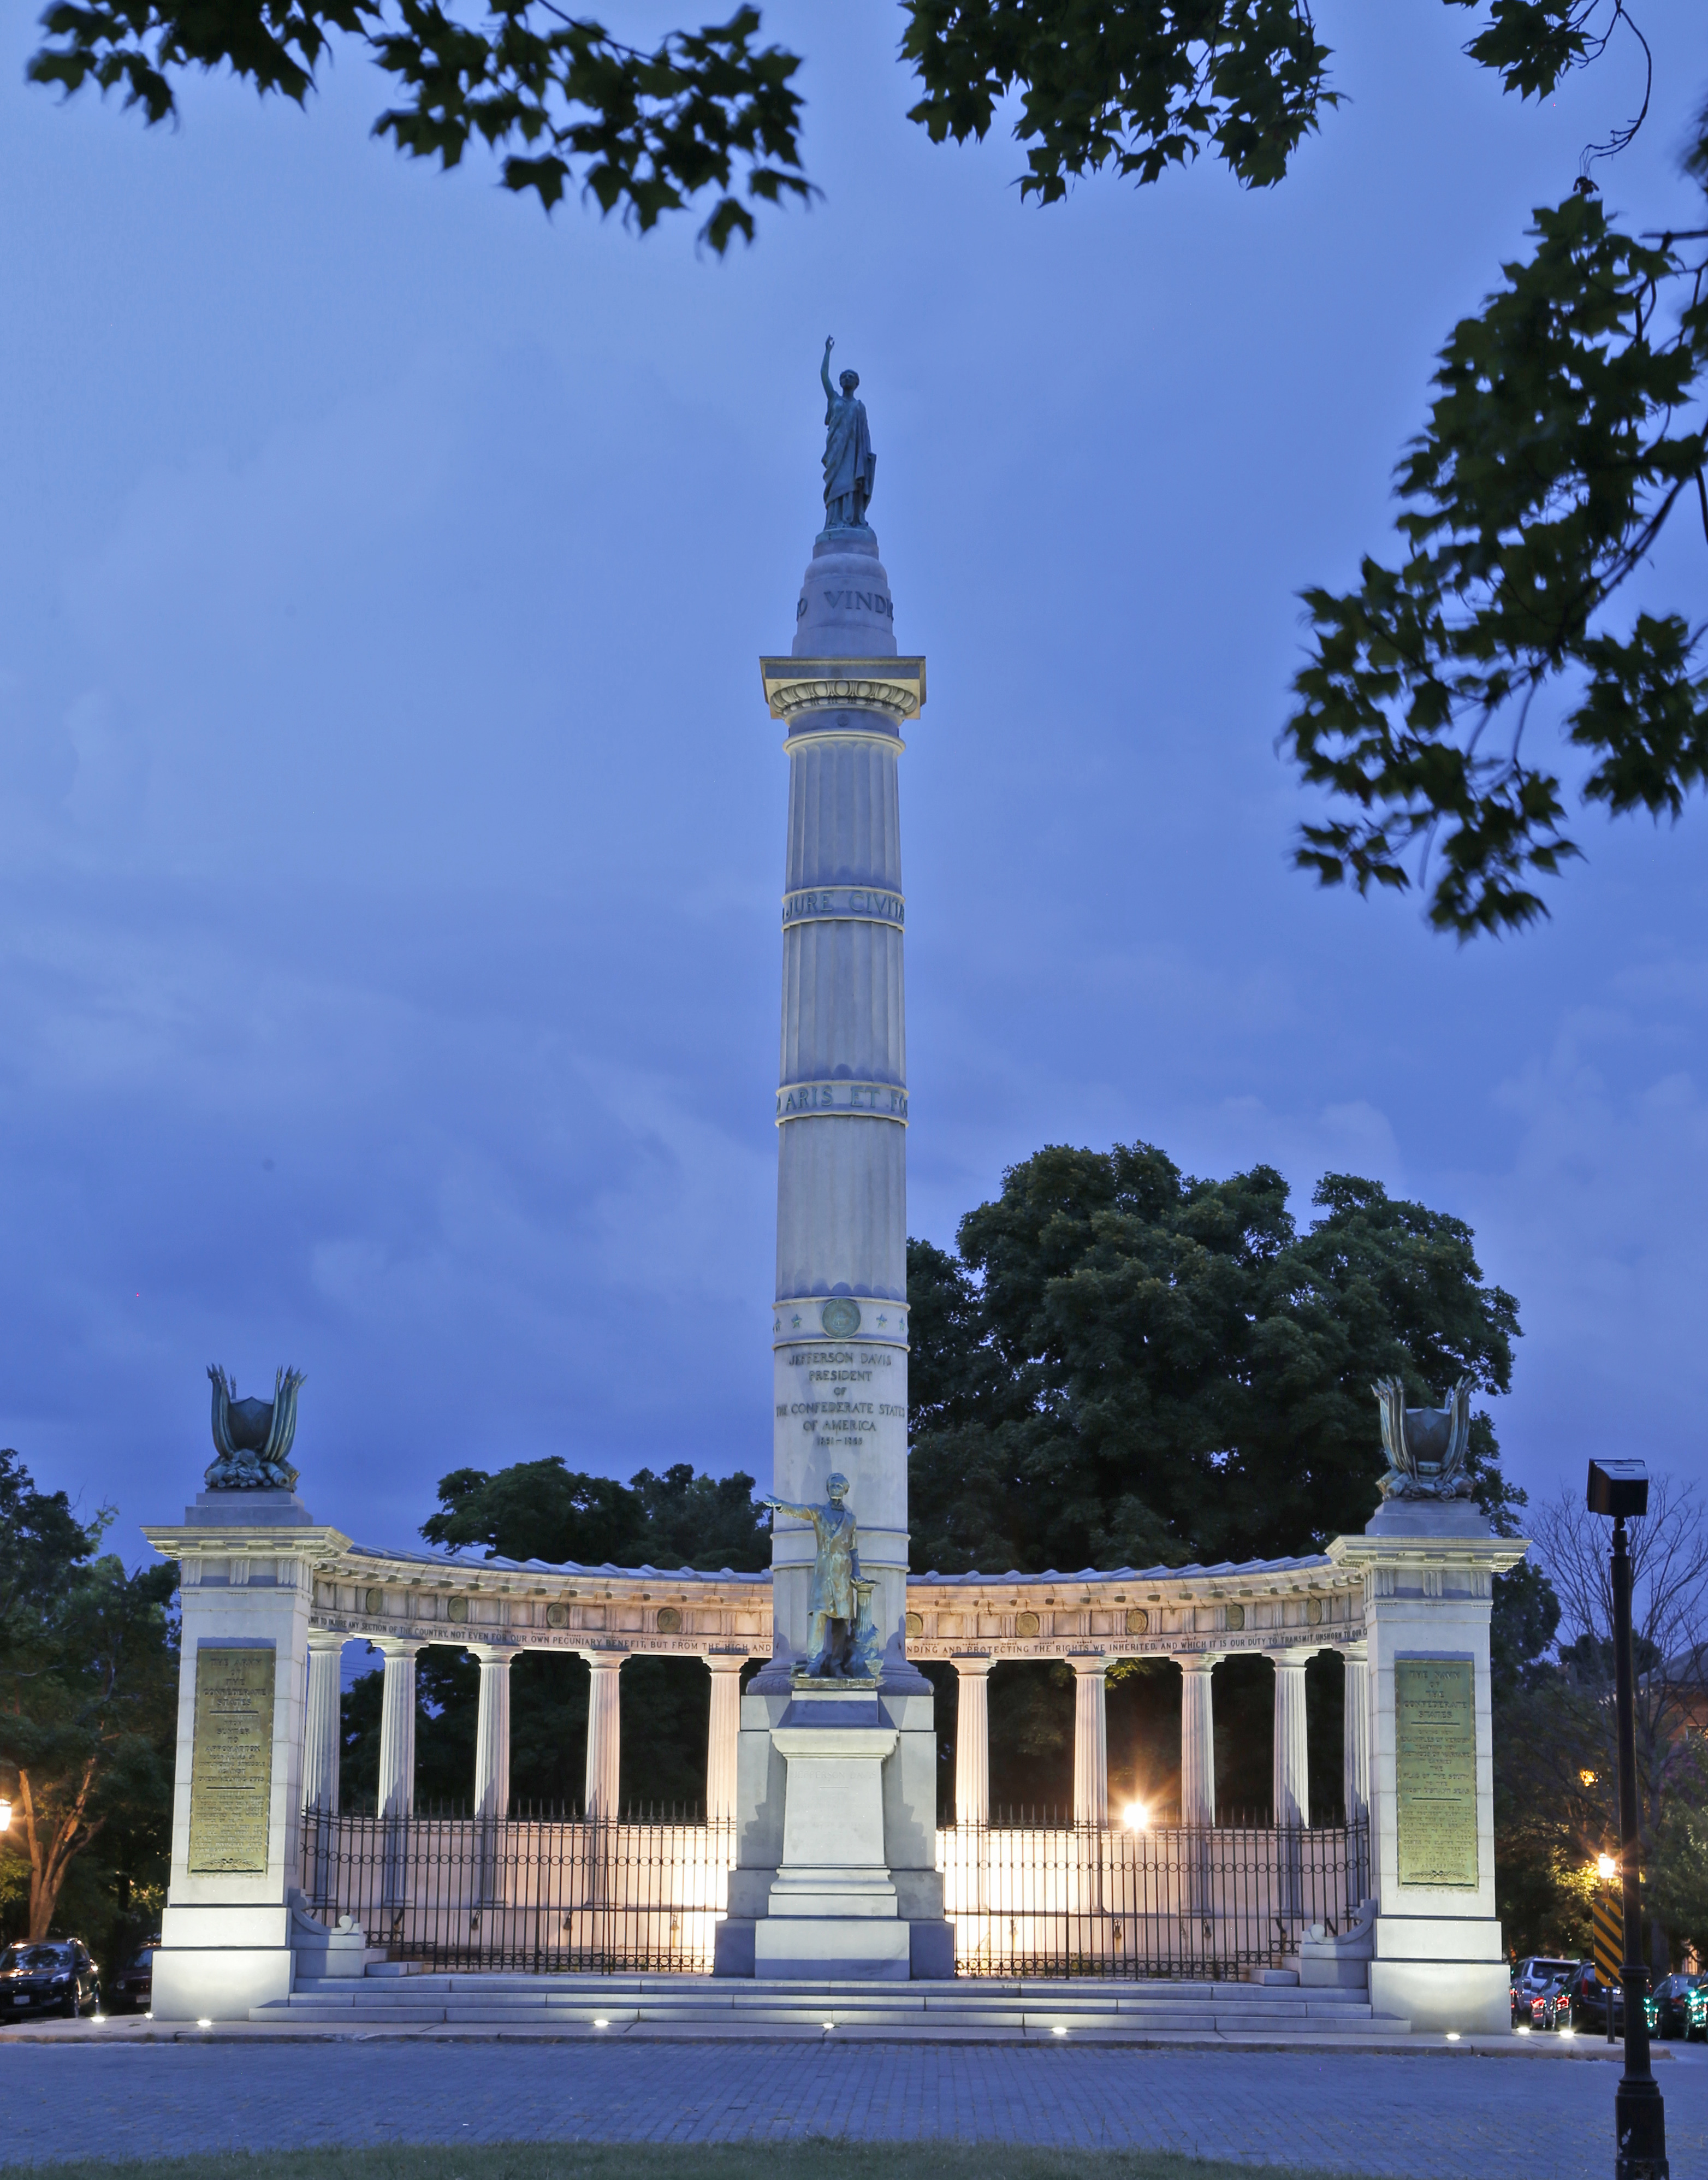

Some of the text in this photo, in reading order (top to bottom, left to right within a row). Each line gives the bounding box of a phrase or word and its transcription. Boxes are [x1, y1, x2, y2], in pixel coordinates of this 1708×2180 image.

[786, 893, 833, 919] JURE
[786, 1087, 833, 1111] ARIS
[851, 1087, 881, 1107] ET
[789, 1352, 892, 1366] JEFFERSON DAVIS
[809, 1370, 872, 1382] PRESIDENT
[833, 1387, 847, 1396] OF
[776, 1402, 905, 1418] THE CONFEDERATE STATES
[803, 1420, 876, 1431] OF AMERICA
[329, 1619, 347, 1628] INJURE
[349, 1621, 360, 1629] ANY
[361, 1622, 387, 1632] SECTION
[400, 1626, 412, 1634] THE
[450, 1631, 465, 1639] NOT
[468, 1632, 488, 1640] EVEN
[511, 1634, 527, 1643] OUR
[531, 1636, 549, 1644] OWN
[553, 1637, 602, 1646] PECUNIARY
[1230, 1639, 1245, 1647] OUR
[1248, 1638, 1266, 1646] DUTY
[1281, 1634, 1313, 1644] TRANSMIT
[1315, 1632, 1342, 1640] UNSHORN
[1352, 1629, 1362, 1637] OUR
[1434, 1671, 1460, 1679] NAVY
[1403, 1701, 1467, 1709] CONFEDERATE
[792, 1770, 845, 1779] JEFFERSON
